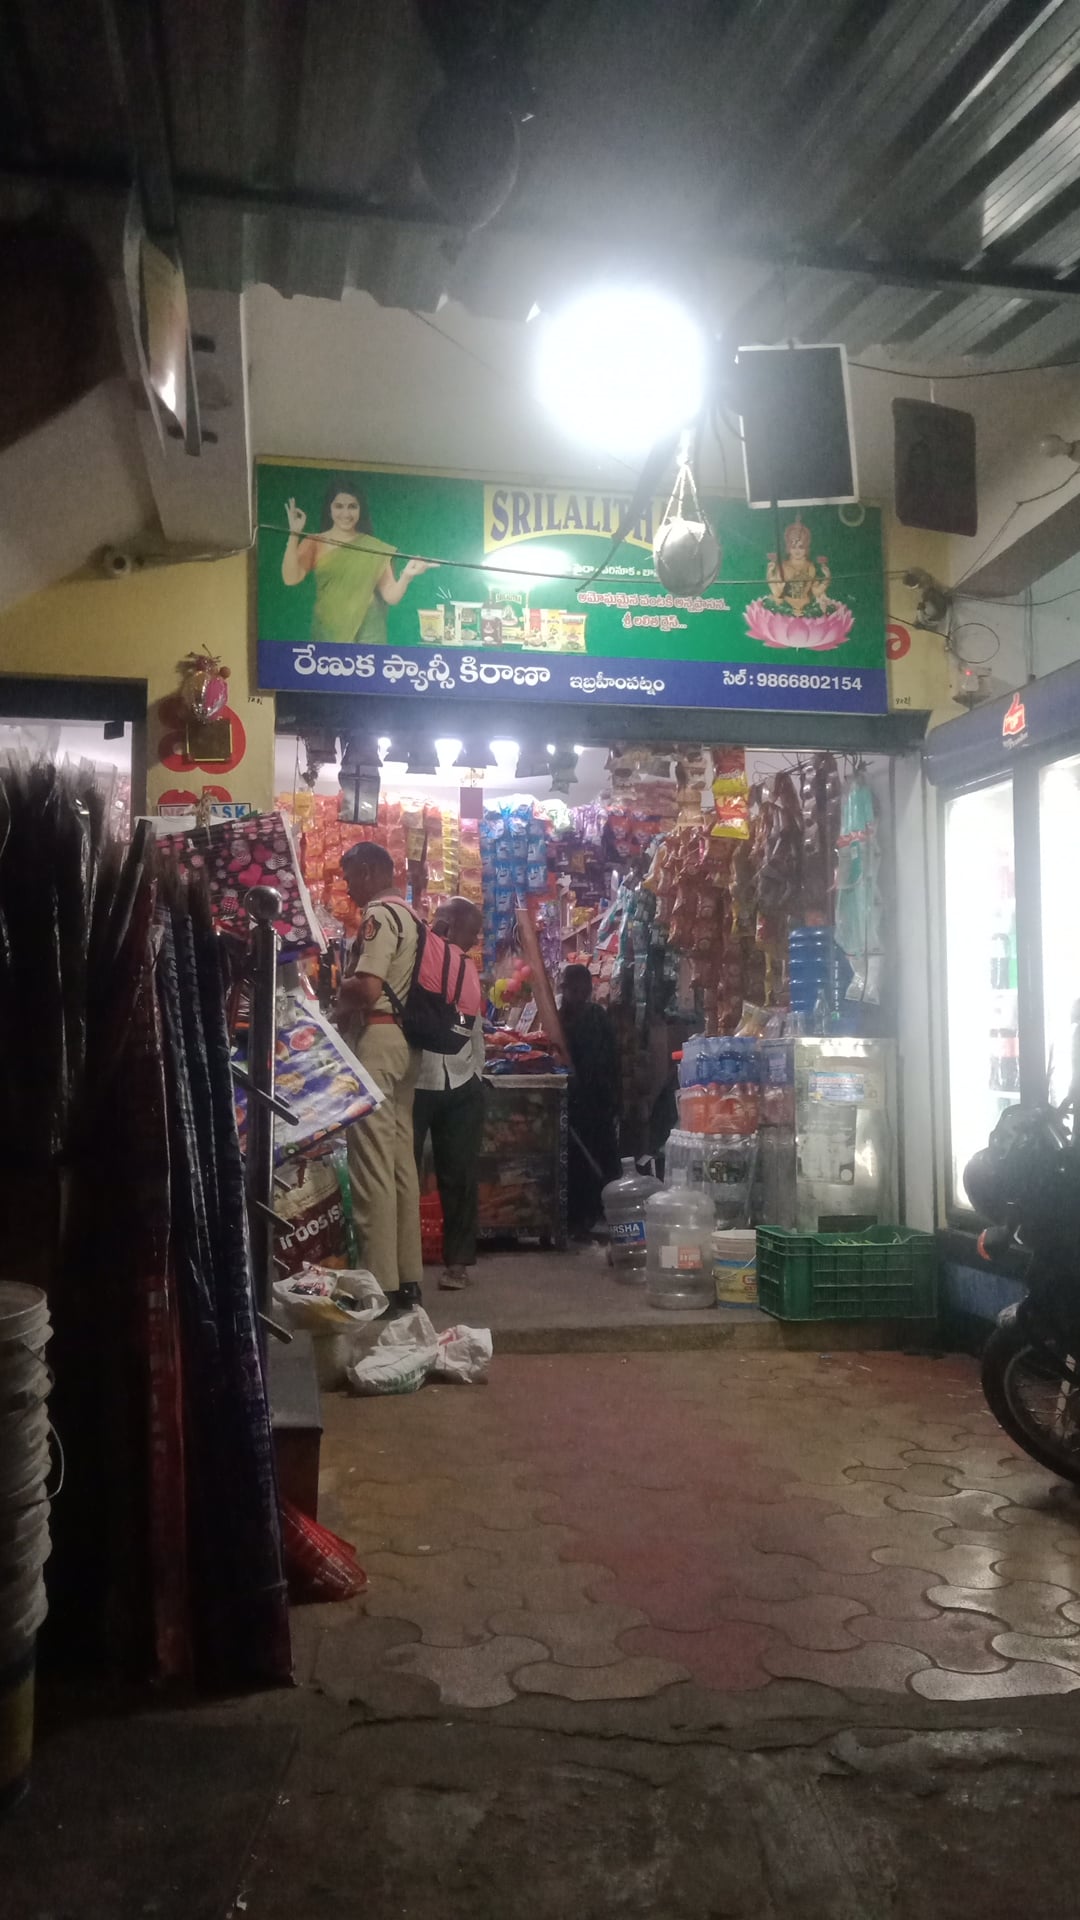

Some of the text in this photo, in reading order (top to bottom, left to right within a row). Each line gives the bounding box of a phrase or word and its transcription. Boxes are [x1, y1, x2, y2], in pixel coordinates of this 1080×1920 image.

[490, 489, 674, 545] SRILALITH
[292, 644, 551, 691] రేణుక ఫ్యాన్సీ కిరాణా
[569, 671, 665, 696] ఇబ్రహీంపట్నం
[757, 673, 863, 691] 9866802154
